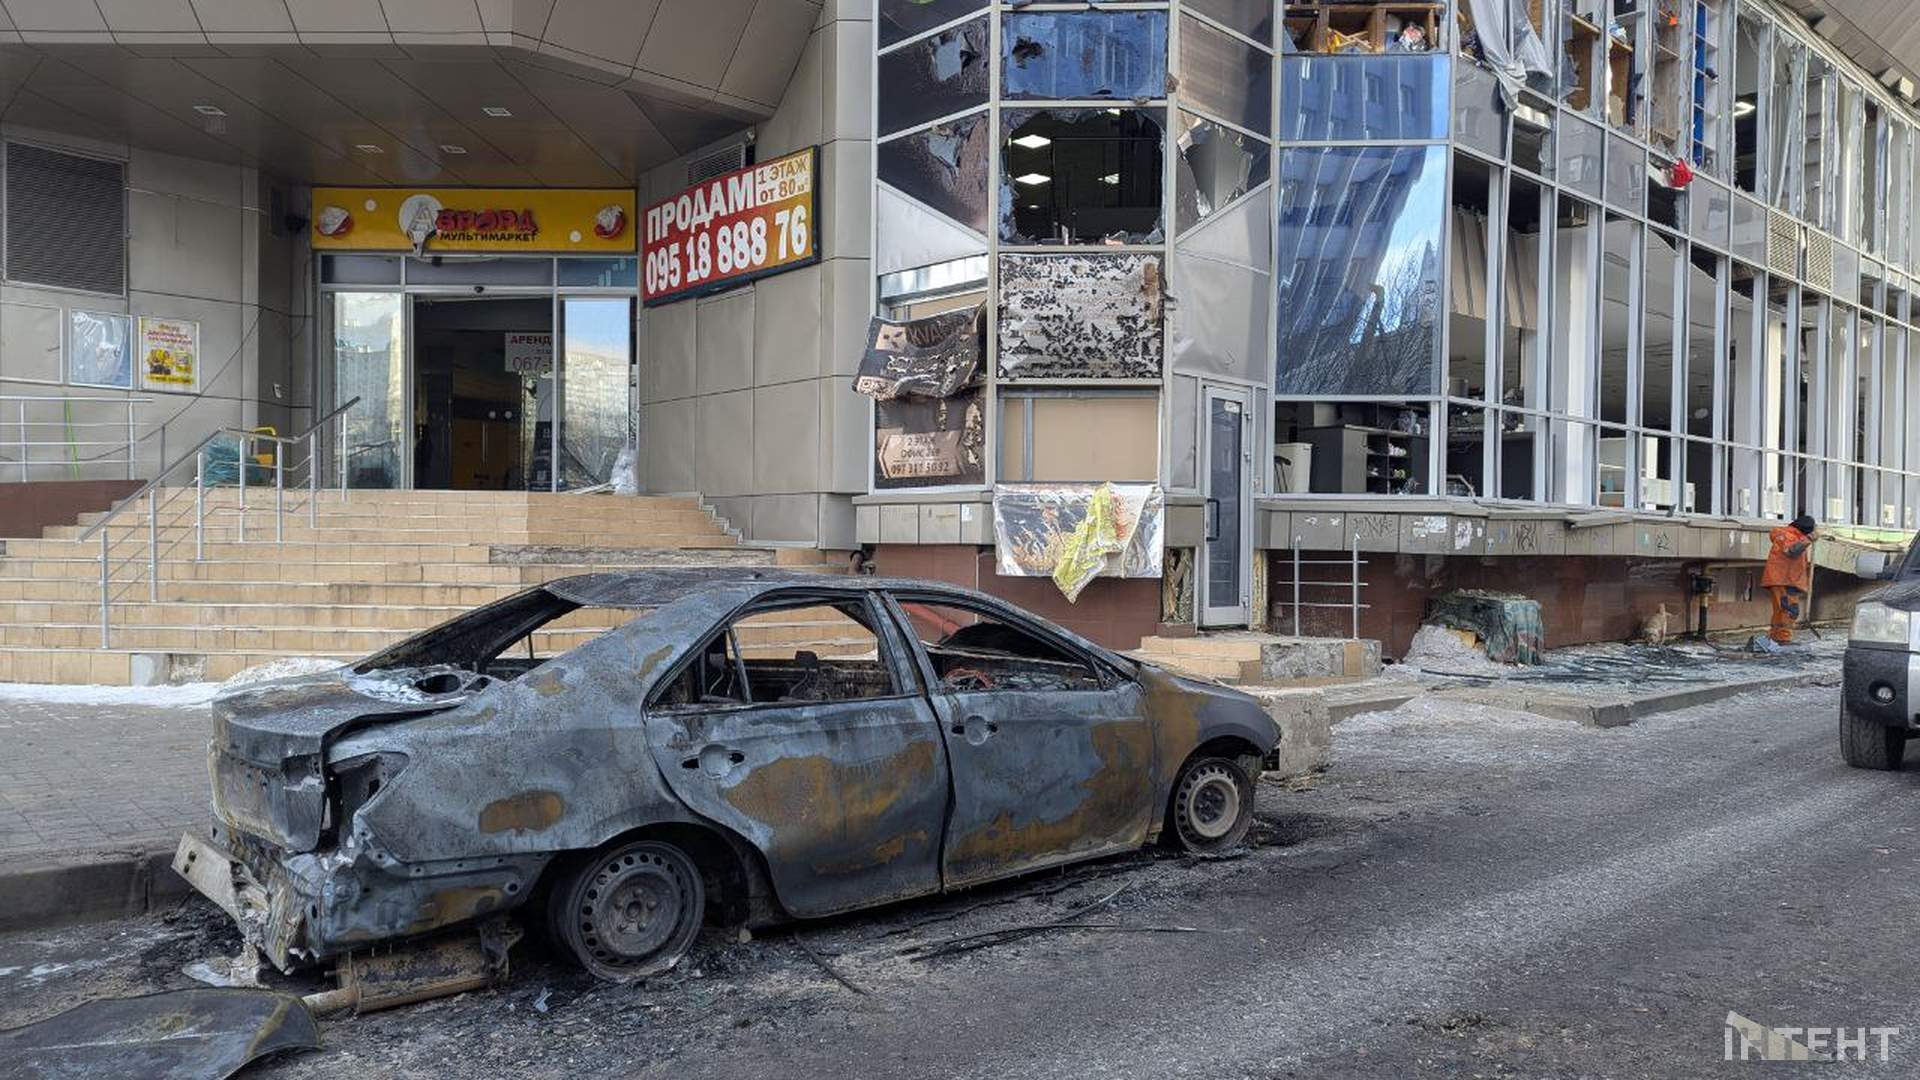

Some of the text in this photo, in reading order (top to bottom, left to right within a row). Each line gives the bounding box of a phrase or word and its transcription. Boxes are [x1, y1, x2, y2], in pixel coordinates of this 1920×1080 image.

[759, 155, 809, 185] 1 ЭТАЖ
[778, 178, 796, 198] 80
[647, 170, 754, 244] ПРОДАМ
[439, 231, 538, 242] МУЛЬТИМАРКЕТ
[646, 204, 807, 295] 095 18 888 76
